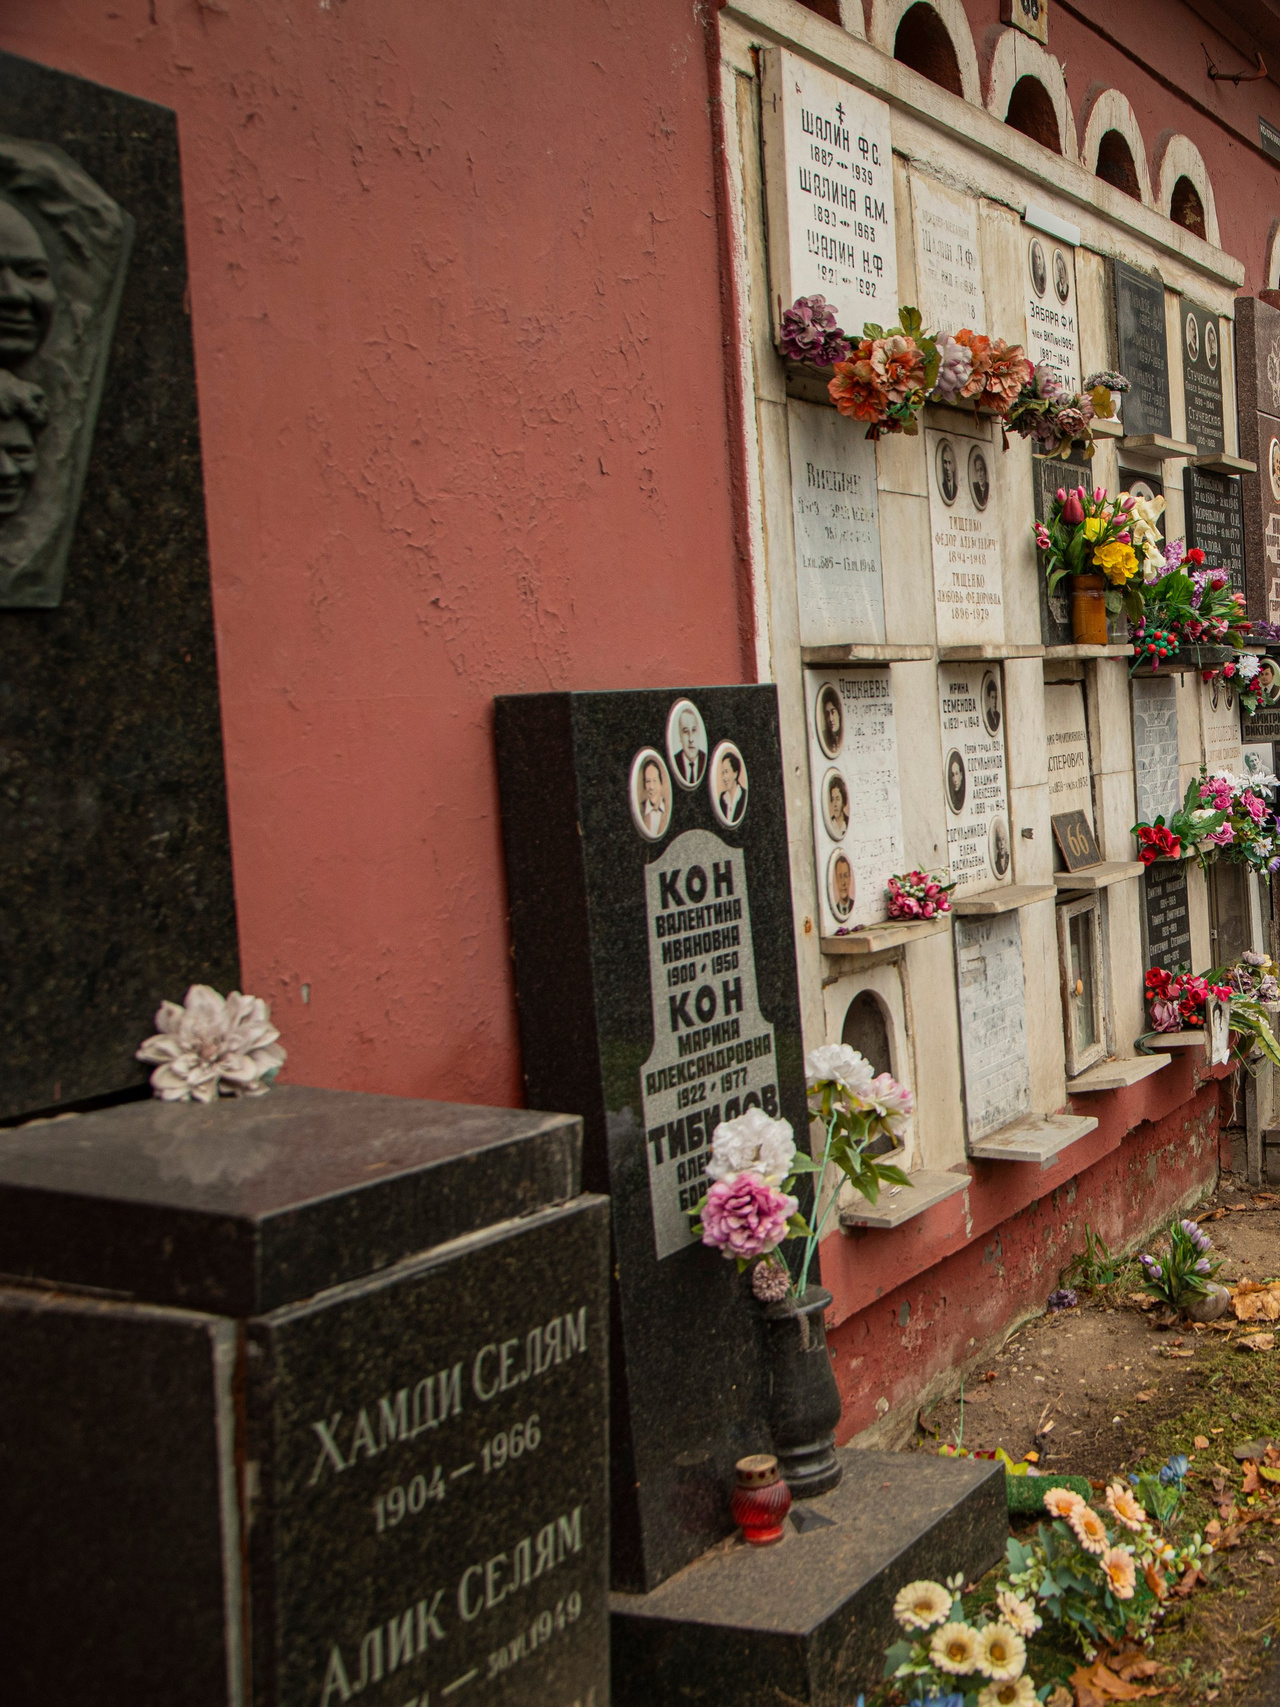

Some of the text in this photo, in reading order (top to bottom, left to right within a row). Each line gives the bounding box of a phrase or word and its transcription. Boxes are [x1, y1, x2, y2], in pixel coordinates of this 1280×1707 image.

[801, 108, 881, 167] ШАЛИН Ф.С.
[810, 144, 873, 186] 1887 1939
[799, 167, 888, 224] ШАЛИНА А.М.
[854, 220, 875, 243] 1963
[807, 229, 884, 278] ШАЛИН Н.Ф.
[1030, 301, 1075, 333] ЗАБАРА Ф.И.
[1188, 406, 1221, 427] СТУЧЕВСКАЯ
[935, 533, 957, 547] ФЕДОР
[949, 516, 982, 532] ТИЩЕНКО
[952, 572, 985, 588] ТИЩЕНКО
[937, 590, 1001, 606] ЛЮБОВЬ ФЕДОРОВНА
[838, 678, 890, 700] ЧУЦКАЕВЫ
[943, 698, 977, 714] СЕМЕНОВА
[949, 683, 970, 695] ИРИНА
[1048, 752, 1085, 772] СПЕРОВИЧ
[973, 786, 1002, 800] АЛЕКСЕЕВИЧ
[974, 773, 999, 787] ВЛАДИМИР
[960, 843, 977, 857] ЕЛЕНА
[1067, 822, 1090, 857] 66
[952, 855, 985, 872] ВАСИЛЬЕВНА
[659, 860, 734, 910] КОН
[655, 898, 743, 938] ВАЛЕНТИНА
[661, 924, 741, 965] ИВАНОВНА
[667, 951, 739, 988] 1900 1950
[668, 976, 744, 1033] КОН
[677, 1017, 740, 1058] МАРИНА
[645, 1033, 772, 1097] АЛЕКСАНДРОВНА
[677, 1066, 748, 1110] 1922 1977
[308, 1305, 588, 1487] ХАМДИ СЕЛЯМ
[375, 1465, 446, 1533] 1904
[481, 1413, 541, 1474] 1966
[322, 1504, 583, 1707] АЛИК СЕЛЯМ
